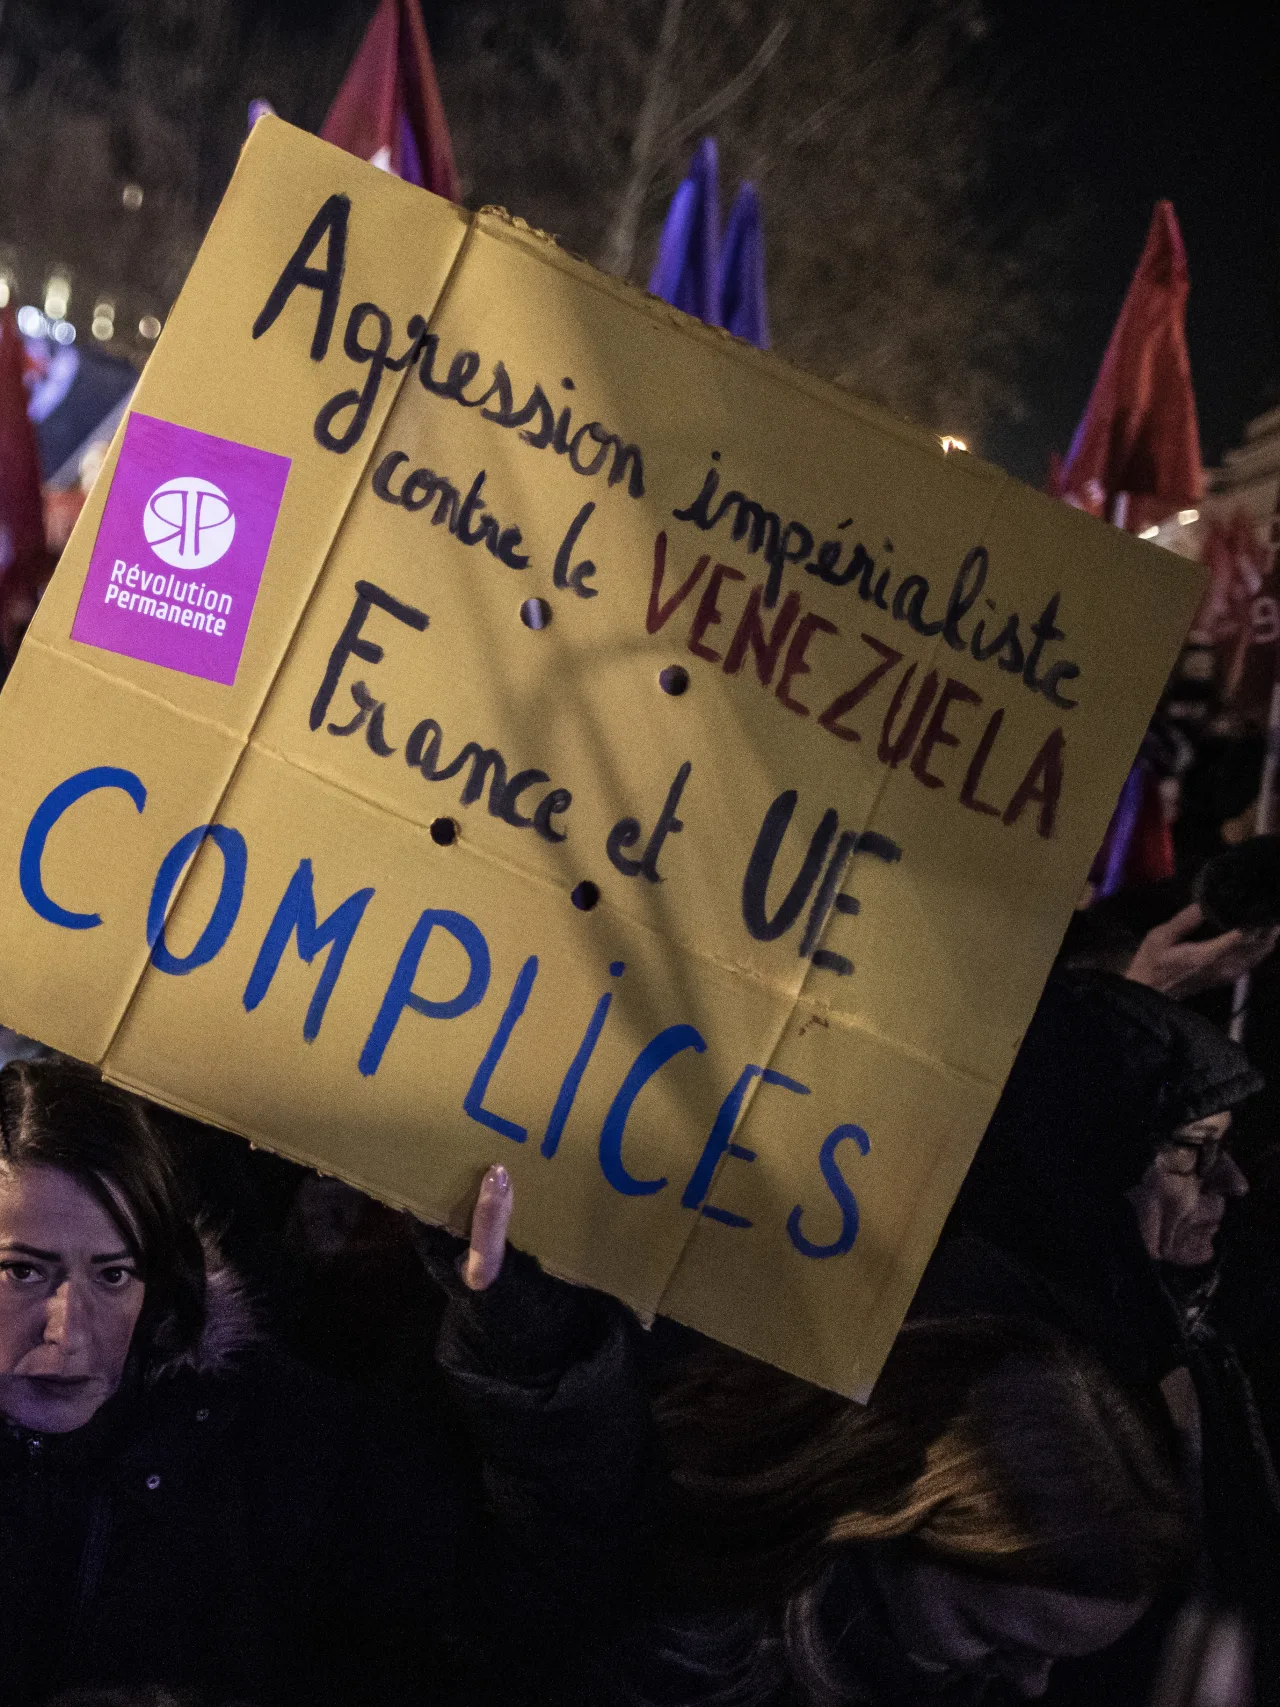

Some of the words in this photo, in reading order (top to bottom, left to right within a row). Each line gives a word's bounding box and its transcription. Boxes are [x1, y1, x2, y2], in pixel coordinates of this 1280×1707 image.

[104, 583, 227, 637] Permanente
[110, 559, 233, 615] Révolution
[252, 192, 645, 499] Agression
[673, 451, 1081, 710] impérialiste
[371, 451, 533, 570] contre
[553, 501, 599, 599] le
[646, 531, 1066, 840] VENEZUELA
[309, 580, 573, 844] France
[606, 760, 692, 883] et
[742, 789, 902, 976] UE
